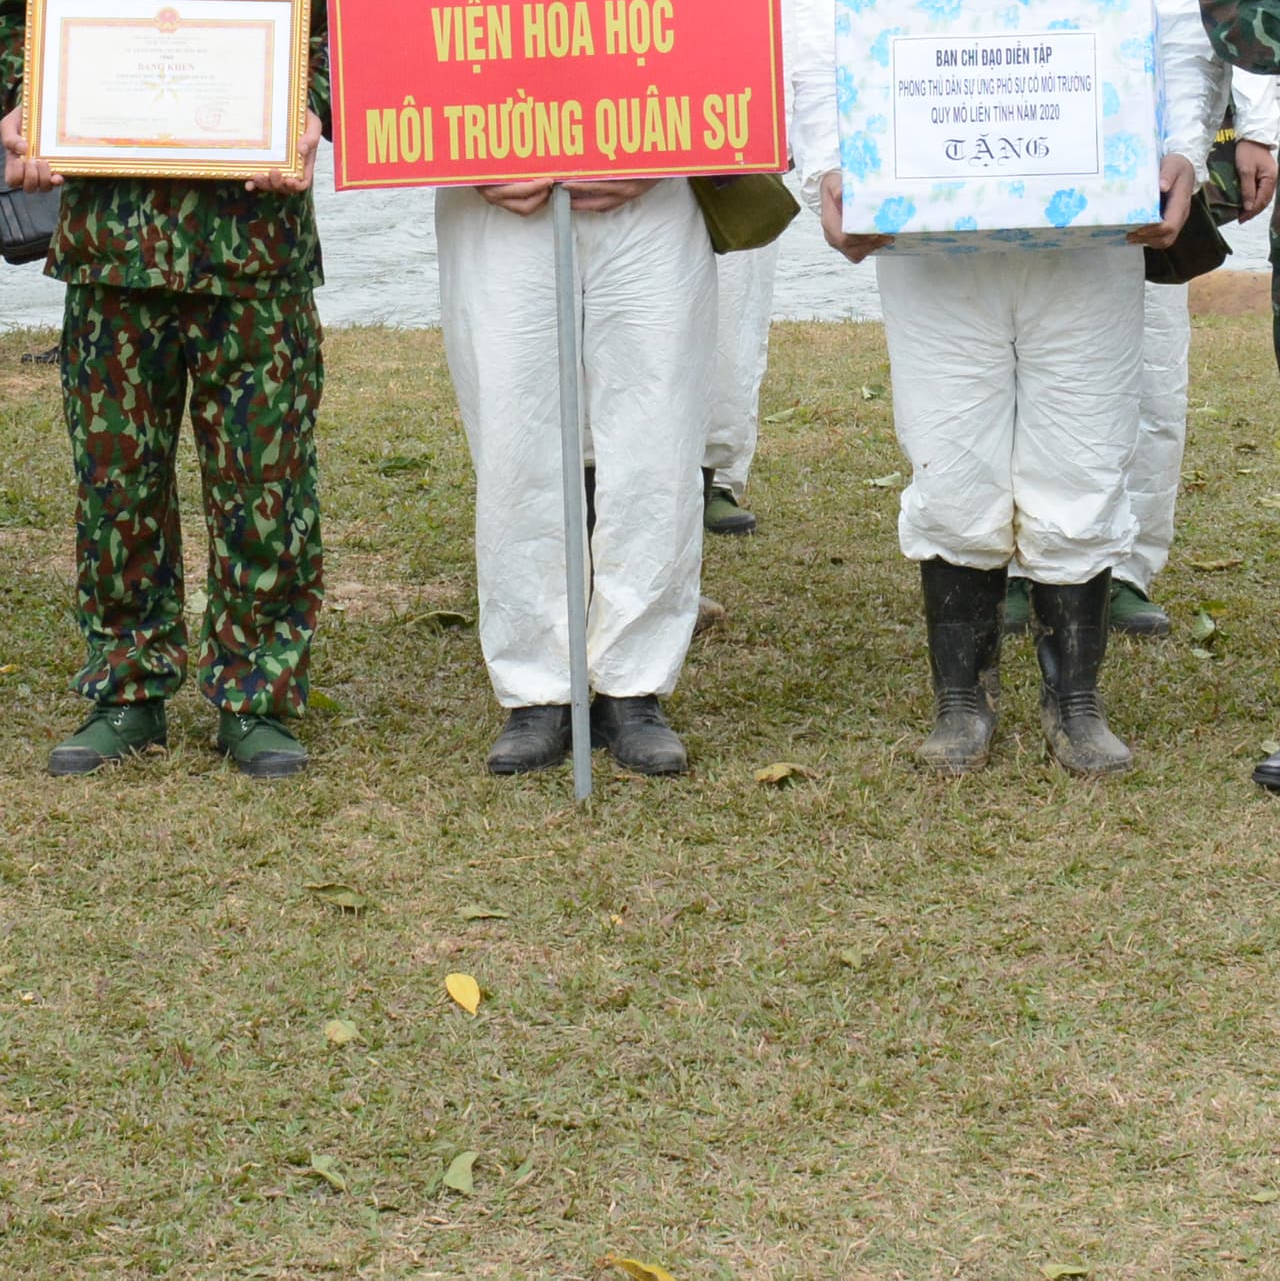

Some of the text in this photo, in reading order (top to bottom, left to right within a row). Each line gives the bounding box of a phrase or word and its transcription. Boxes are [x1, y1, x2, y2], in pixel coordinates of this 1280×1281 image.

[936, 40, 1052, 71] BAN CHỈ ĐẠO DIỄN TẬP
[898, 77, 926, 97] PHÒNG
[927, 74, 943, 96] THỦ
[945, 74, 962, 96] DÂN
[963, 78, 976, 99] SỰ
[1015, 76, 1027, 99] SỰ
[1040, 72, 1056, 93] MÔI
[365, 85, 752, 165] MÔI TRƯỜNG QUÂN SỰ
[931, 106, 951, 124] QUY
[953, 102, 968, 123] MÔ
[970, 102, 991, 122] LIÊN
[1016, 100, 1038, 121] NĂM
[1039, 103, 1061, 121] 2020
[943, 132, 1050, 168] TẶNG
